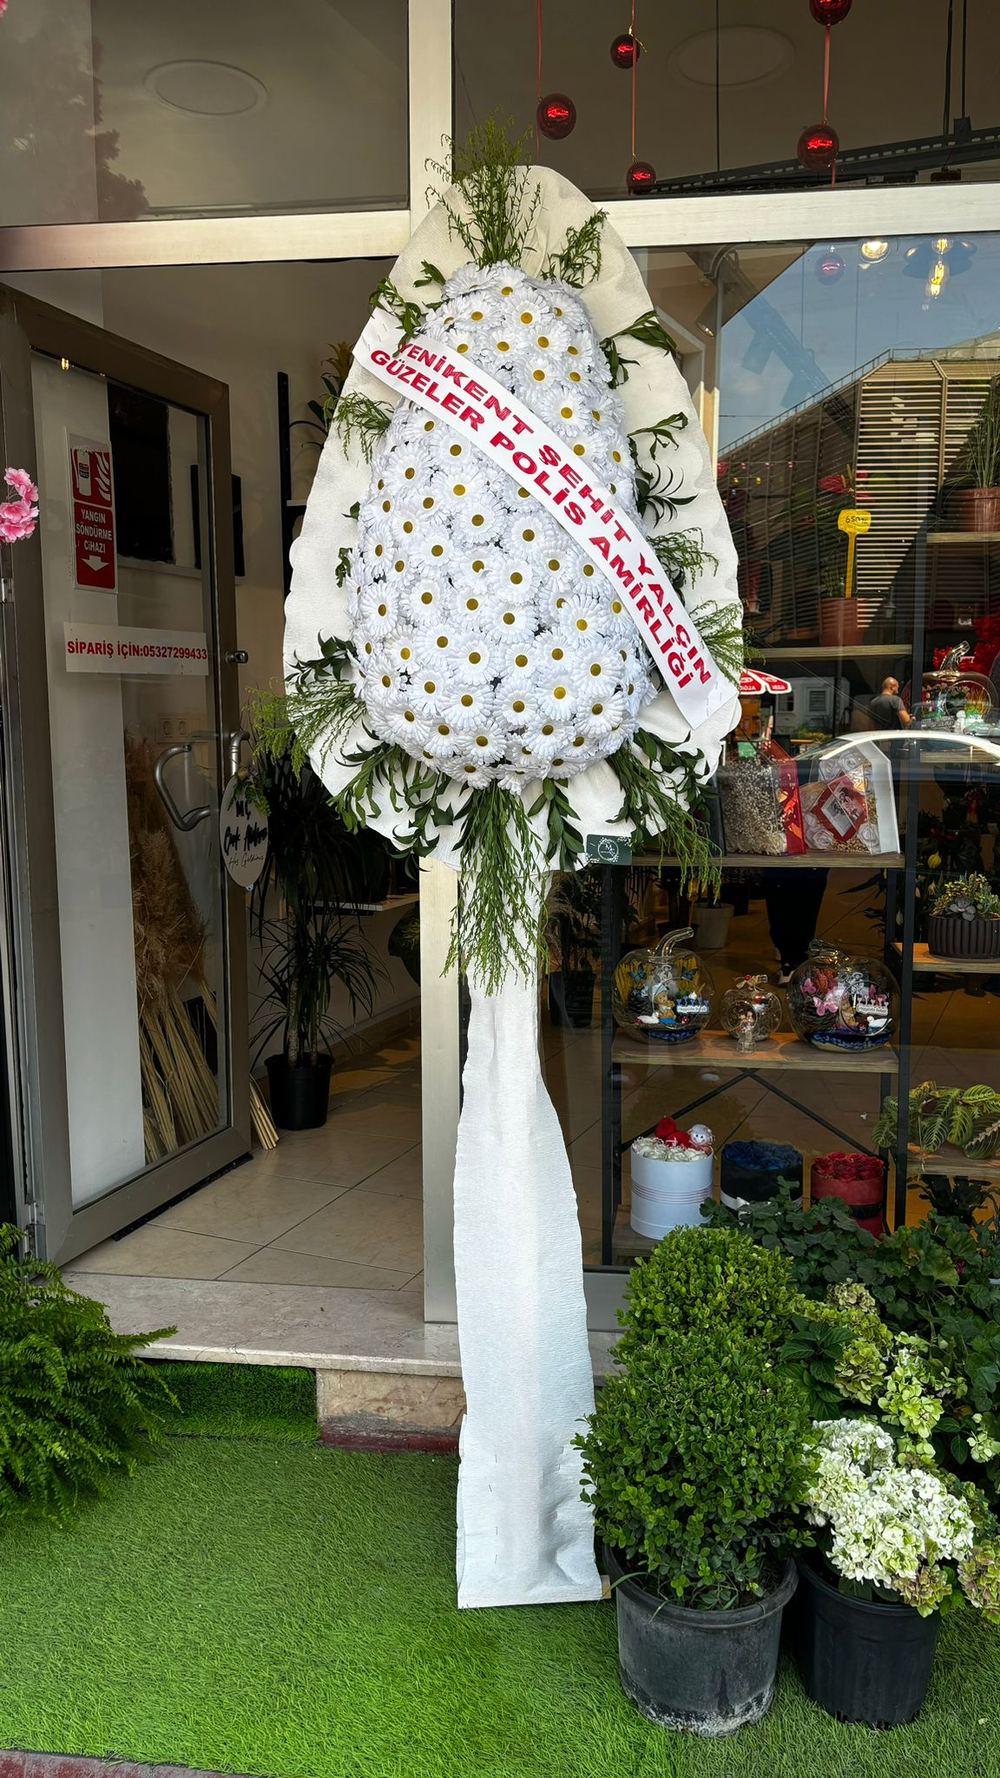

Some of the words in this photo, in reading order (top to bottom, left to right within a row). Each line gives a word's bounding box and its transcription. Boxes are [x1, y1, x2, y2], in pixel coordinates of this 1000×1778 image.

[80, 508, 106, 524] YANGIN
[370, 349, 486, 432] GÜZELER
[490, 431, 586, 525] POLİS
[588, 536, 694, 688] AMİRLİĞİ
[400, 343, 534, 434] YENİKENT
[539, 445, 632, 542] ŞEHİT
[638, 552, 711, 684] YALÇIN
[76, 521, 112, 540] SÖNDÜRME
[67, 638, 113, 658] SİPARİŞ
[117, 640, 207, 660] İÇİN:05327299433
